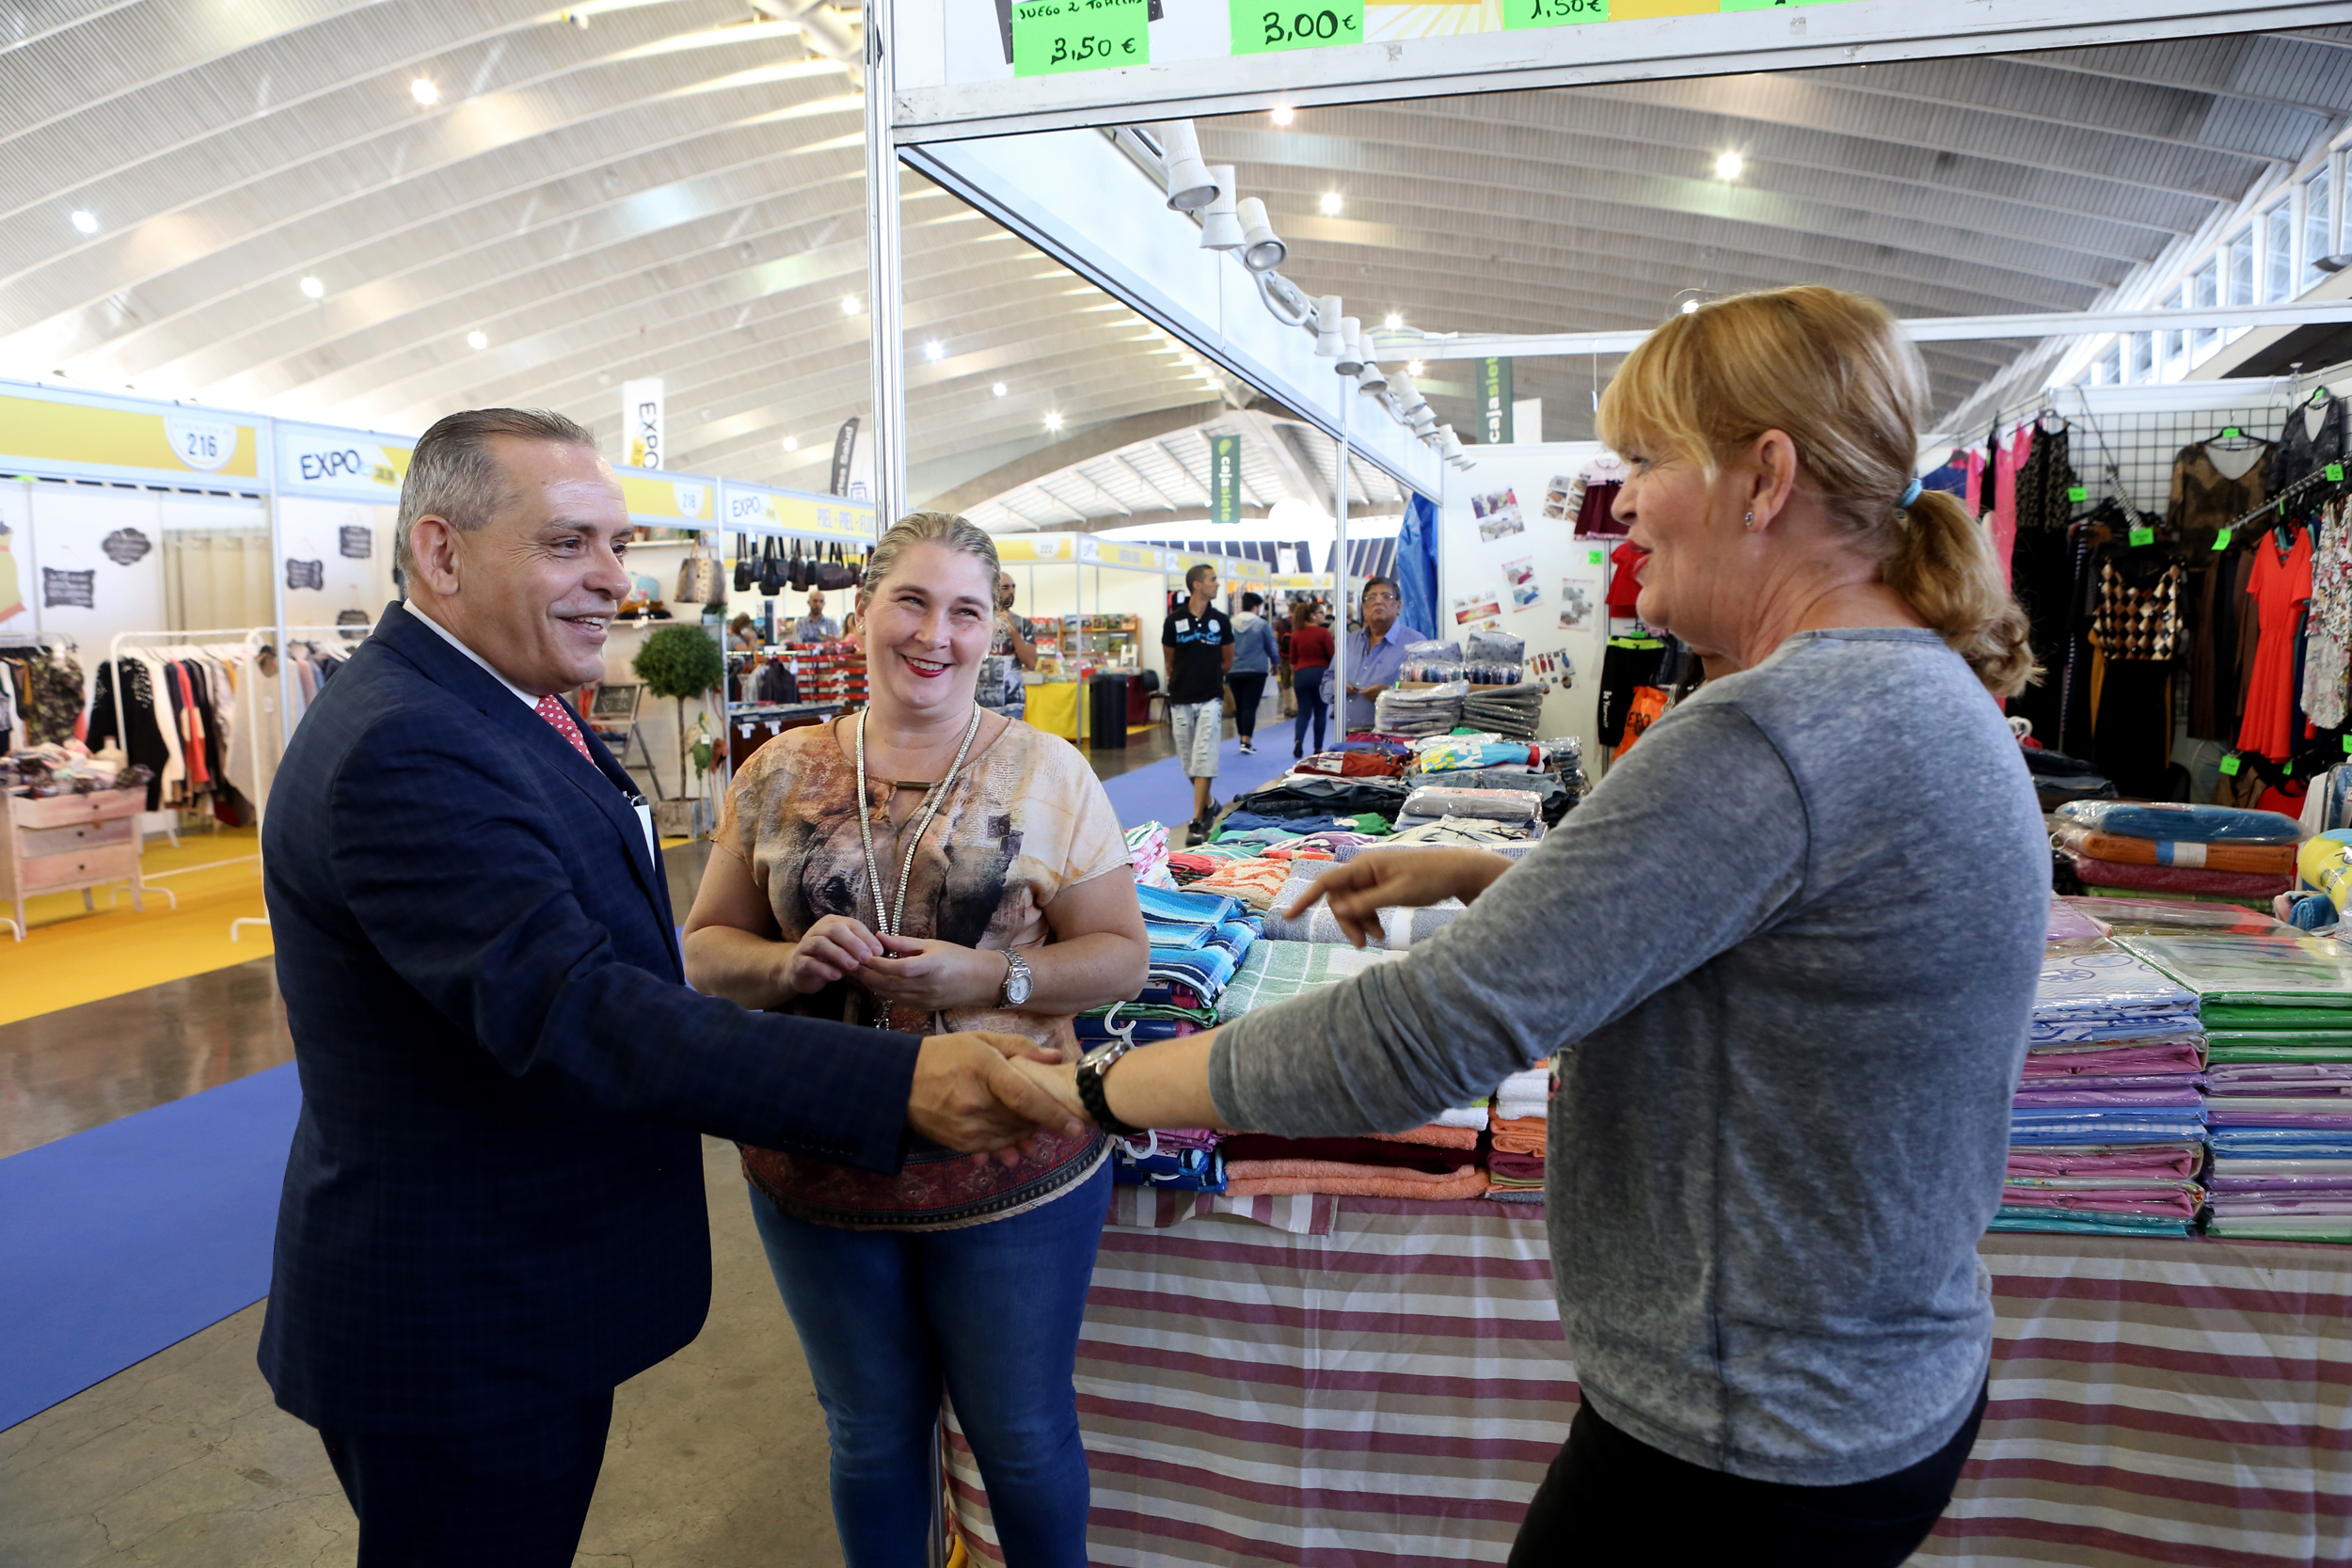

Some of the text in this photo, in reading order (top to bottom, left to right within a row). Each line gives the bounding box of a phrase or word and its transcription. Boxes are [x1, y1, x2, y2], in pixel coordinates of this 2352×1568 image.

[1019, 6, 1060, 20] JUEGO
[1068, 2, 1080, 12] 2
[1050, 36, 1136, 65] 3,50 €
[187, 433, 217, 457] 216
[639, 403, 660, 468] EXPO
[300, 449, 360, 480] EXPO
[1218, 456, 1232, 522] cajasiete
[732, 496, 760, 517] EXPO
[1039, 544, 1053, 554] 222
